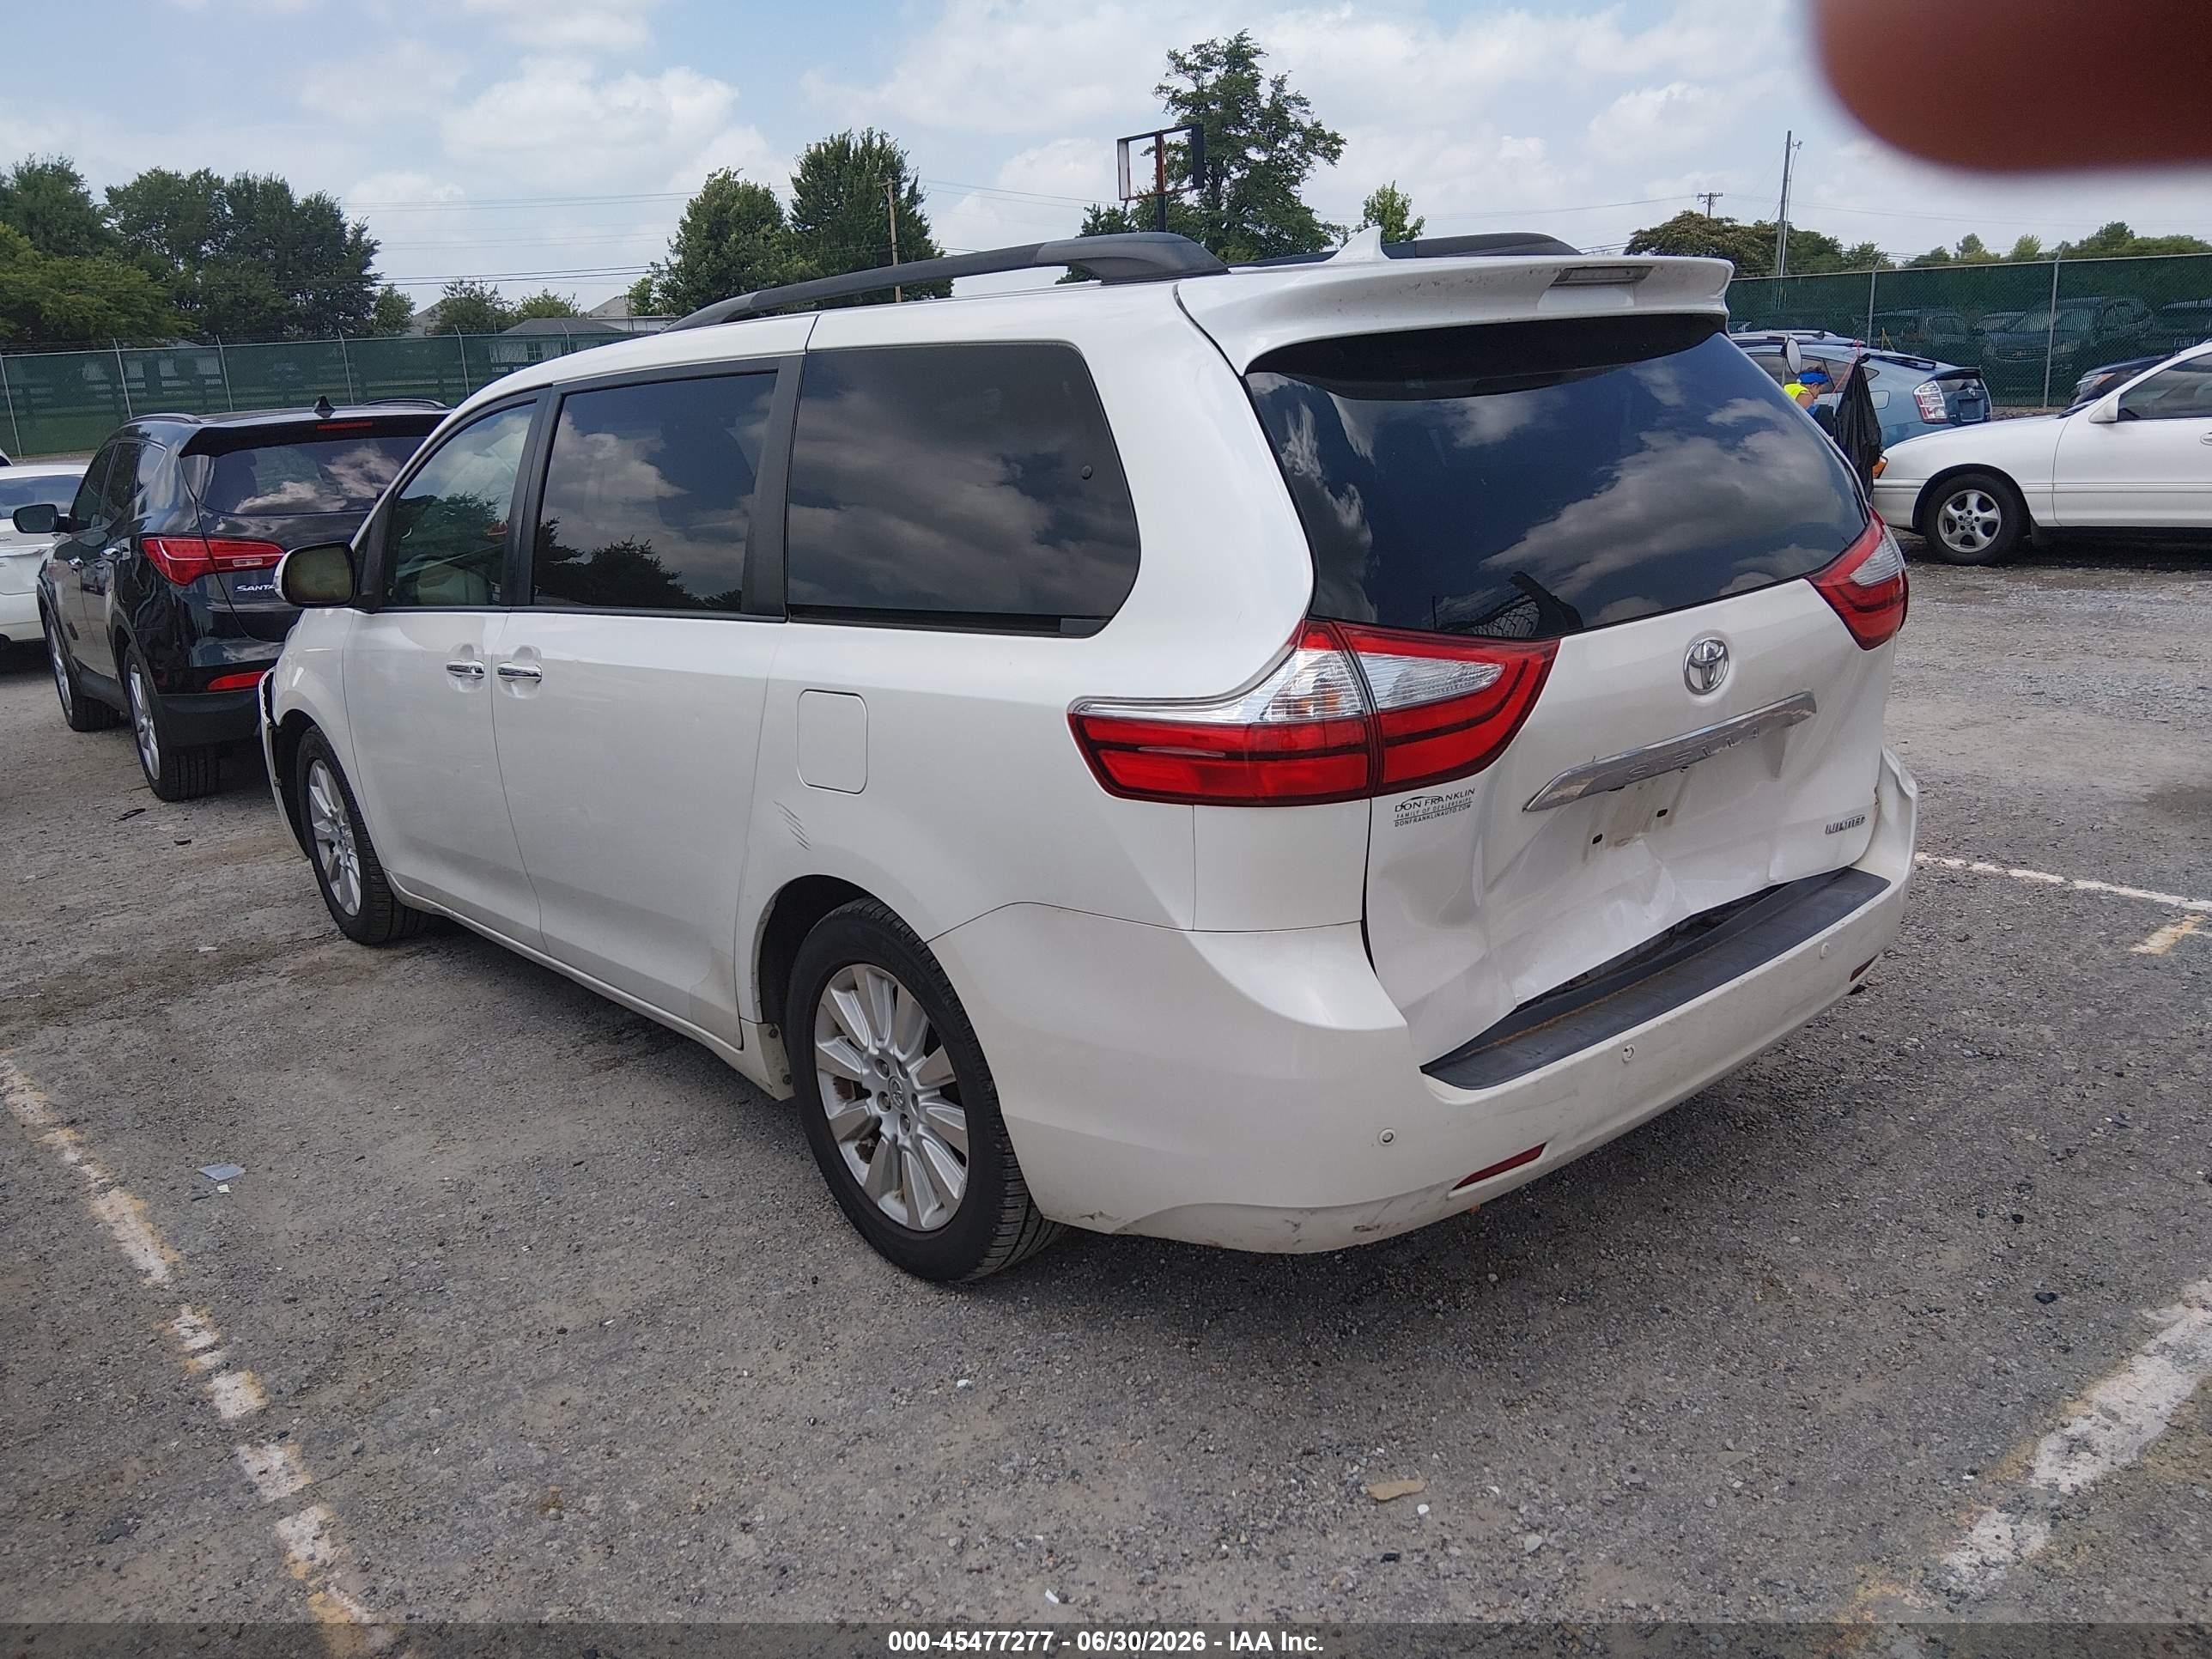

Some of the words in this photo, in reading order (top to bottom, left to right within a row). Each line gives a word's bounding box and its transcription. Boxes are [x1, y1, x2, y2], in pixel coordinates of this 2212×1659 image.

[1395, 799, 1422, 812] DON
[1424, 787, 1475, 806] FRANKLIN
[1395, 803, 1472, 828] DONFRANKLINAUTO.COM
[1396, 810, 1419, 819] FAMILY
